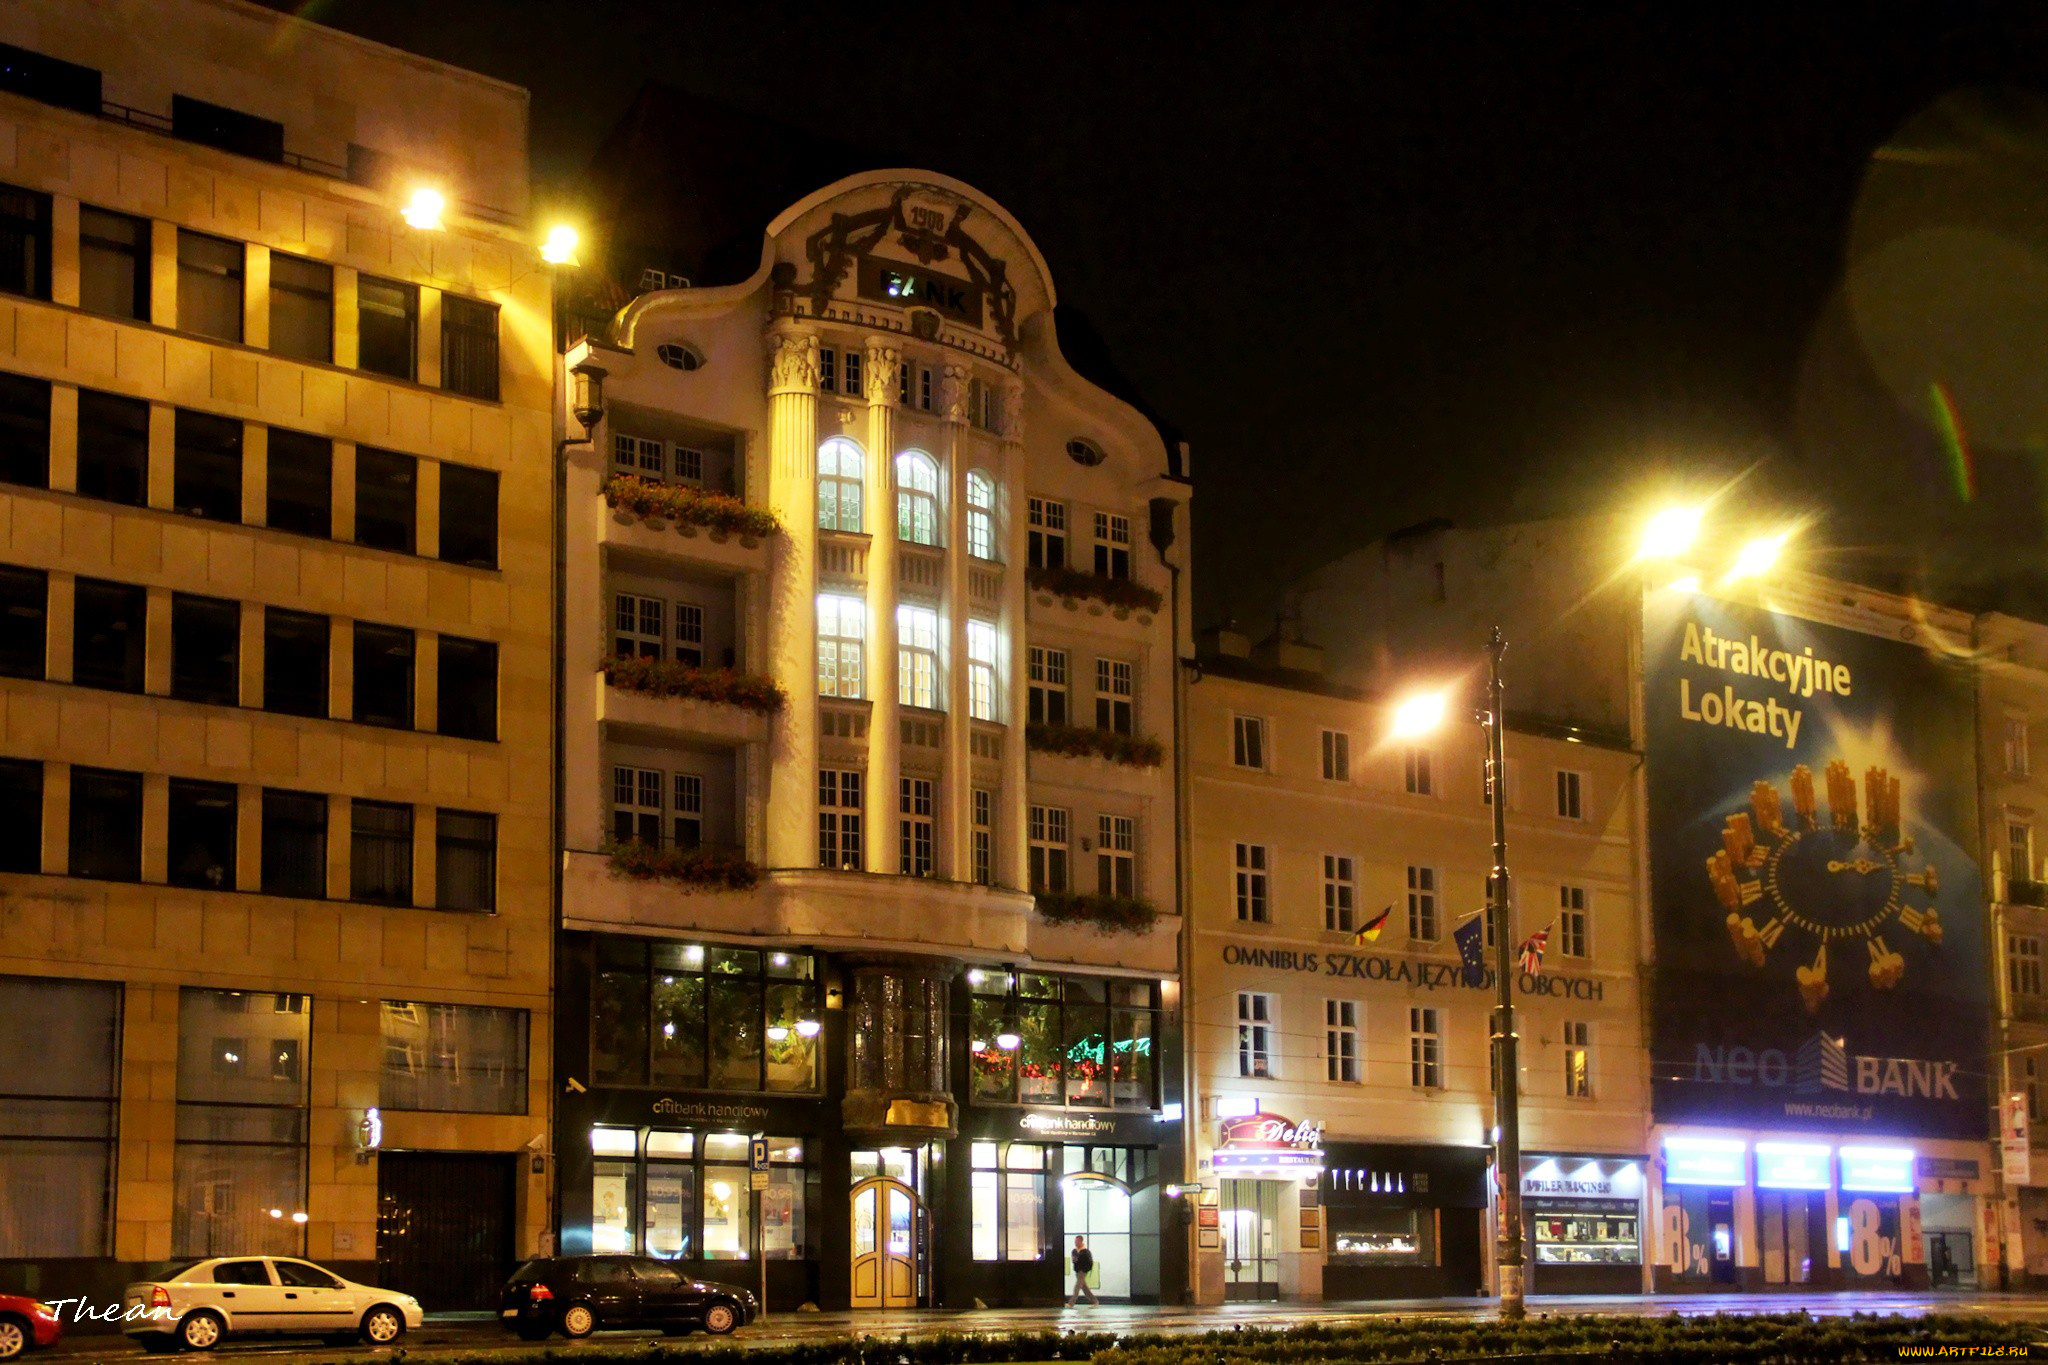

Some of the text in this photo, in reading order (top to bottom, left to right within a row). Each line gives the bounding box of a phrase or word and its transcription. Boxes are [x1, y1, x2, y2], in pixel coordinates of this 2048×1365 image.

[1680, 622, 1850, 698] Atrakcyjne
[1680, 678, 1802, 750] Lokaty
[1223, 945, 1318, 972] OMNIBUS
[1325, 953, 1412, 982] SZKOŁA
[1518, 972, 1603, 1000] OBCYCH
[1856, 1056, 1959, 1099] BANK
[652, 1098, 706, 1114] citibank
[1785, 1103, 1873, 1119] www.neobank.pl
[754, 1143, 764, 1168] P
